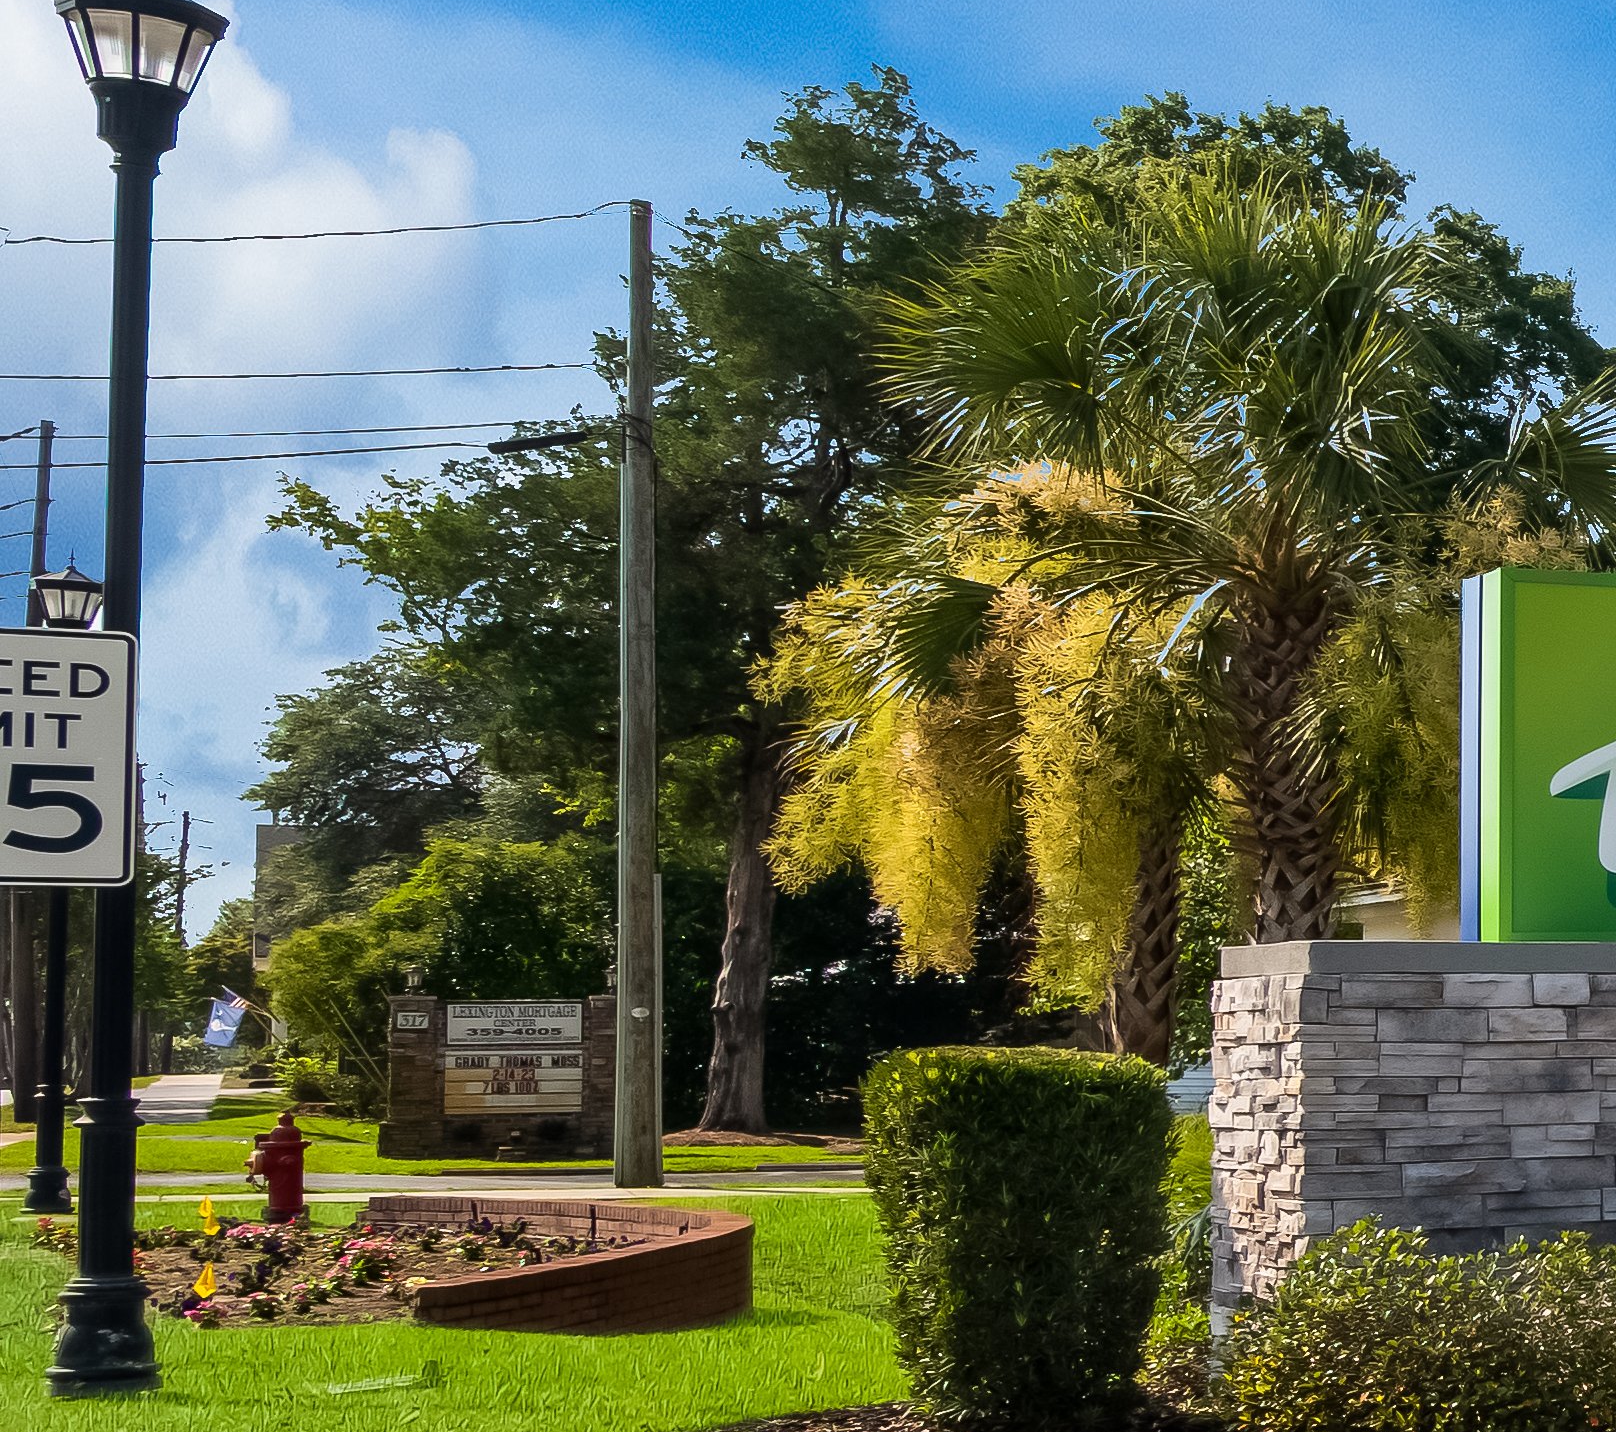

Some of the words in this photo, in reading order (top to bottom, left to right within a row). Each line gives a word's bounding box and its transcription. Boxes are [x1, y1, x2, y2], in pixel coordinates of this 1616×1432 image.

[0, 711, 82, 749] IT
[3, 763, 103, 854] 5
[452, 1005, 515, 1018] LEXINGTON
[518, 1004, 577, 1018] MORTGAGE
[493, 1019, 537, 1027] CENTER
[466, 1027, 562, 1036] 359-4005
[455, 1056, 490, 1067] GRADY
[499, 1056, 542, 1067] THOMAS
[551, 1055, 580, 1067] MOSS
[492, 1069, 536, 1079] 2-14-23
